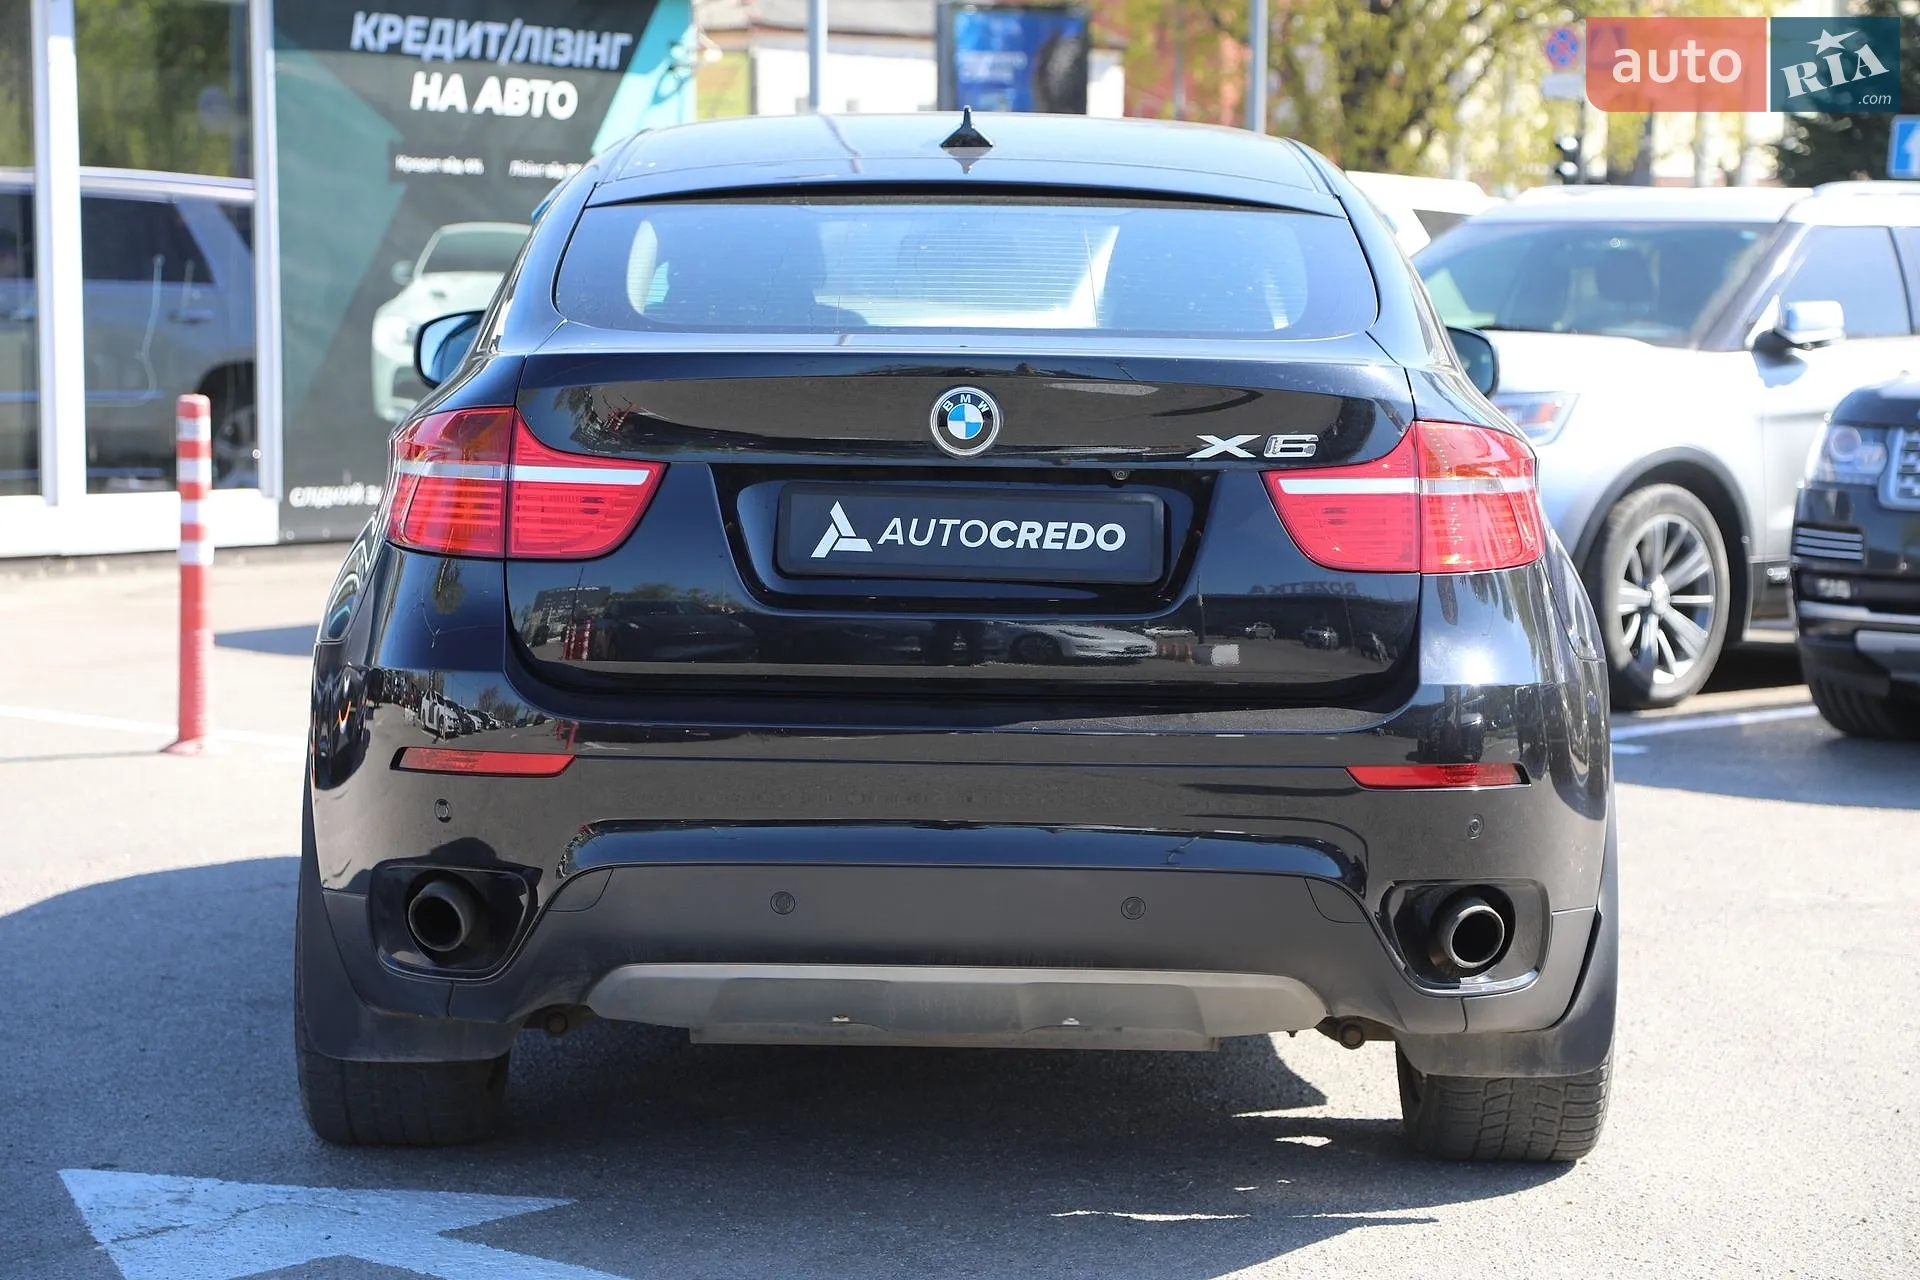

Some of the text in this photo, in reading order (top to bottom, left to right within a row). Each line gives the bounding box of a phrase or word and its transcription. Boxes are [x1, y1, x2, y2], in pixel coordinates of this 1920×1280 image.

[350, 11, 633, 70] КРЕДИТ/ЛІЗІНГ
[410, 71, 579, 121] НА АВТО
[942, 393, 990, 413] BMW
[1186, 434, 1320, 459] X6
[877, 516, 1127, 552] AUTOCREDO
